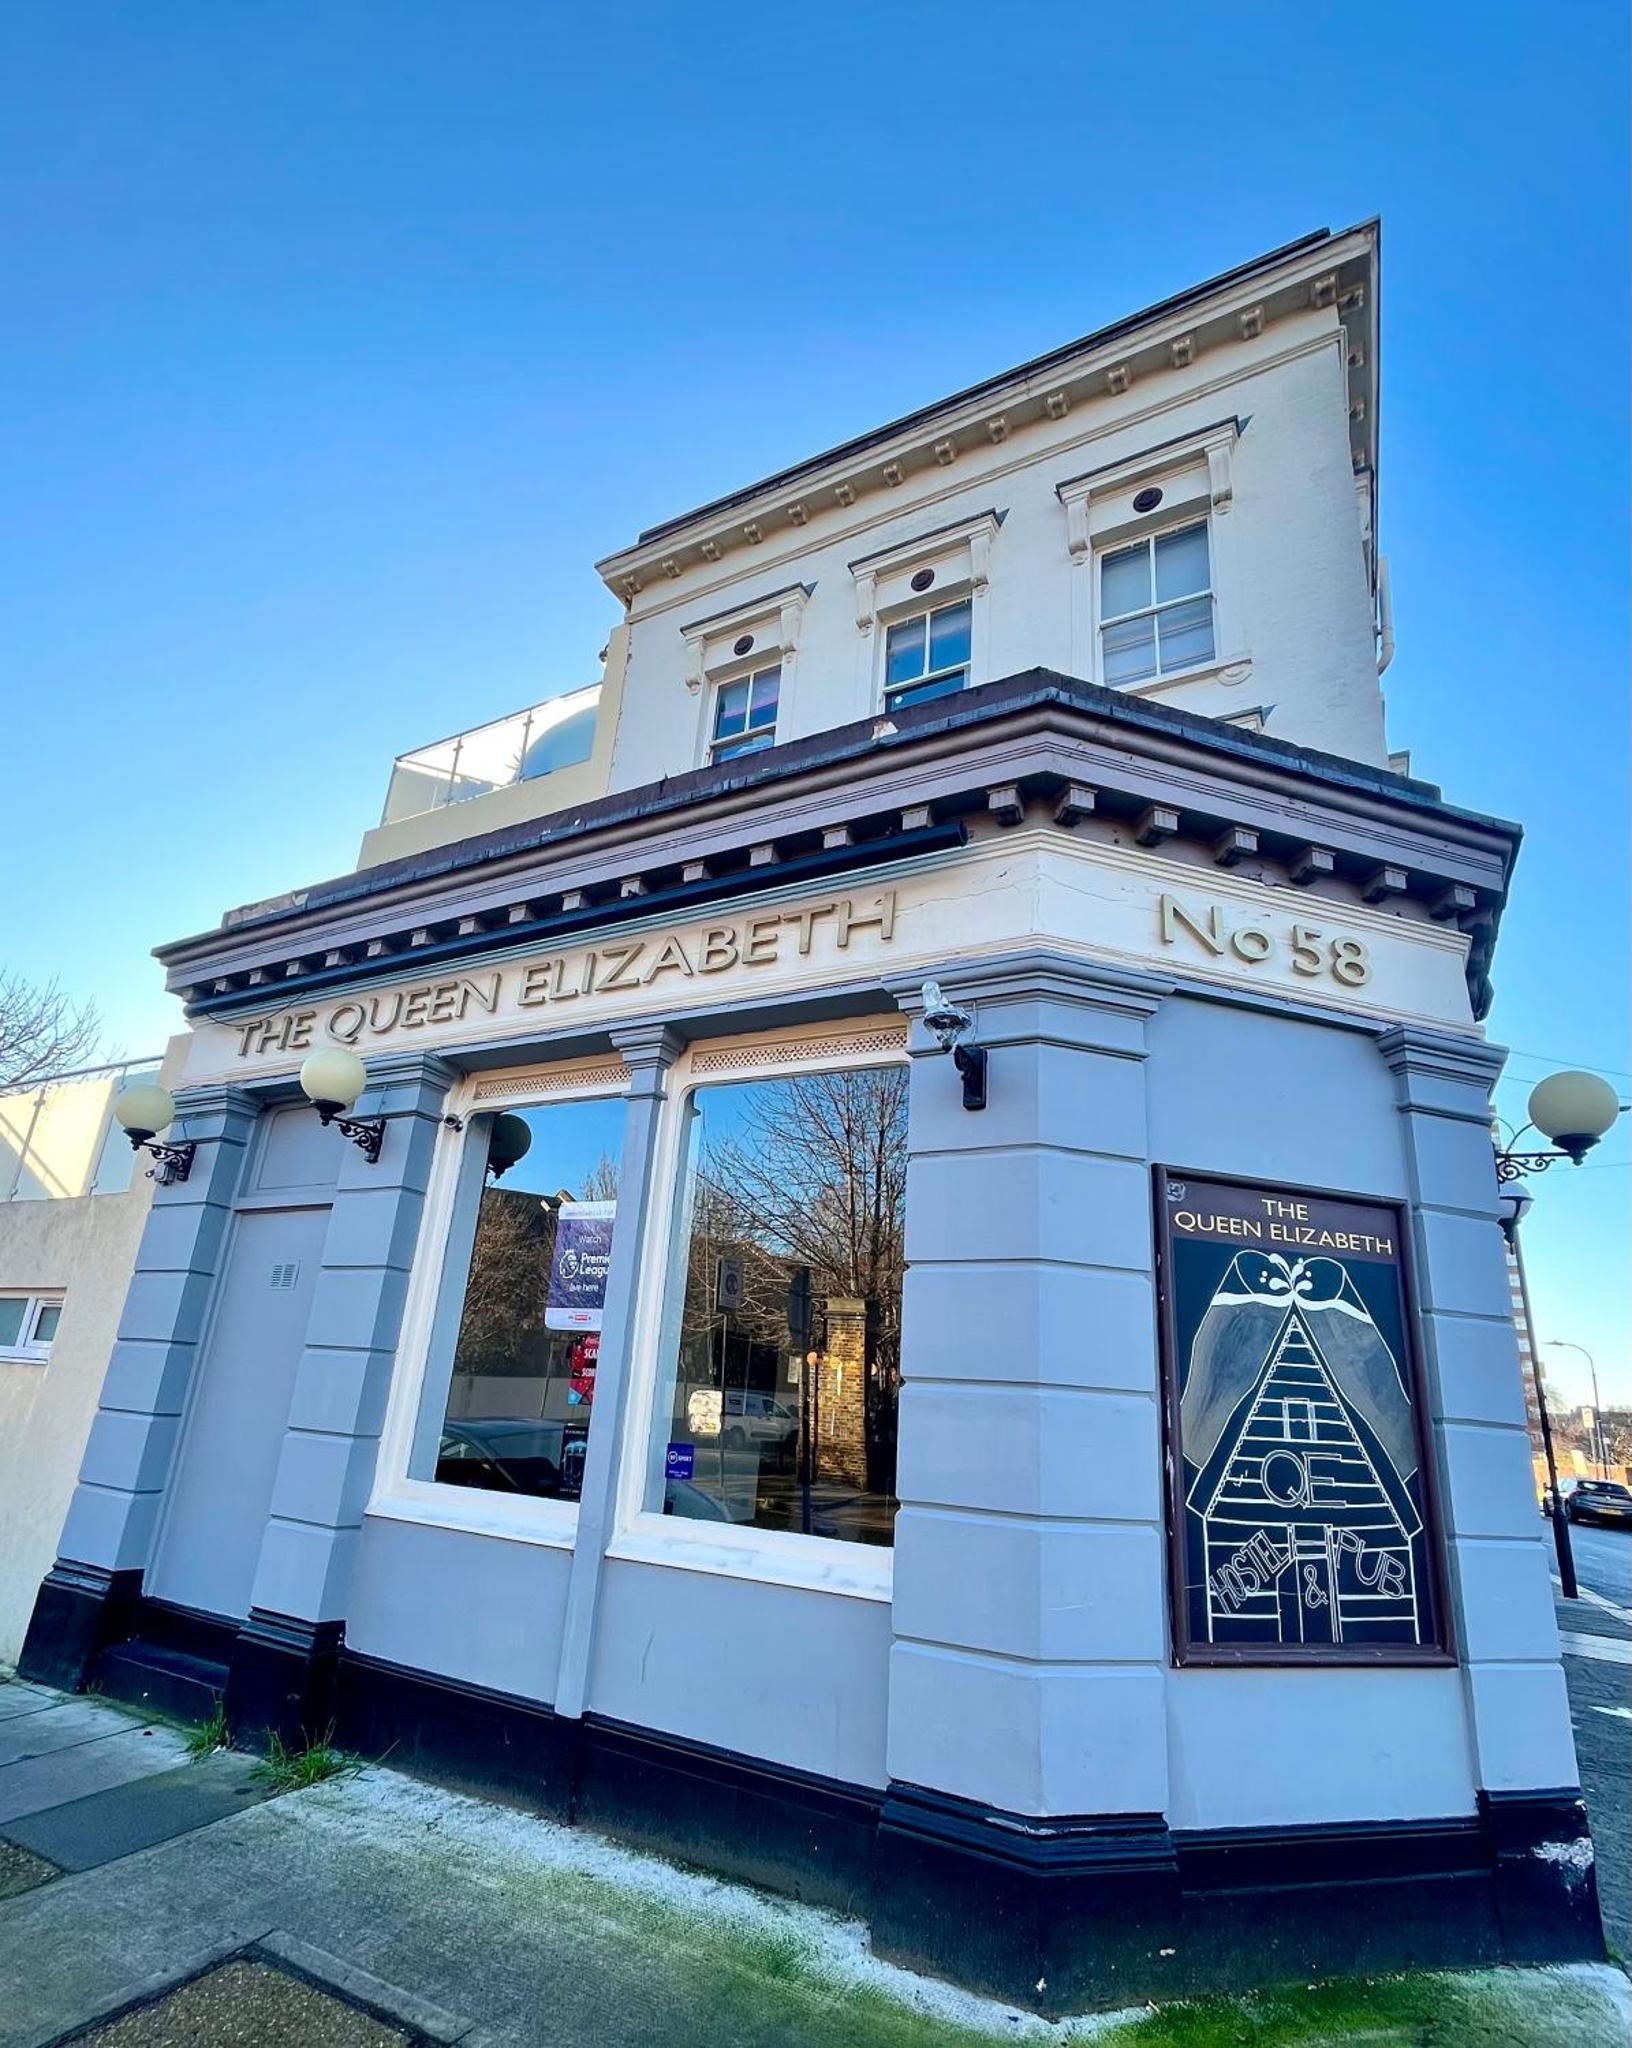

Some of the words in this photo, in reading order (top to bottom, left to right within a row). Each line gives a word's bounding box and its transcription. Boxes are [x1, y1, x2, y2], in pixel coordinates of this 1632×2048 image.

[236, 1010, 316, 1057] THE
[325, 972, 501, 1044] QUEEN
[516, 890, 898, 1007] ELIZABETH
[1160, 893, 1275, 964] No
[1291, 924, 1374, 987] 58
[1174, 1210, 1263, 1239] QUEEN
[1269, 1223, 1394, 1256] ELIZABETH
[1261, 1198, 1310, 1222] THE
[1260, 1449, 1347, 1510] QE
[1209, 1529, 1291, 1615] HOSTEL
[1303, 1564, 1329, 1609] &
[1335, 1528, 1406, 1599] PUB
